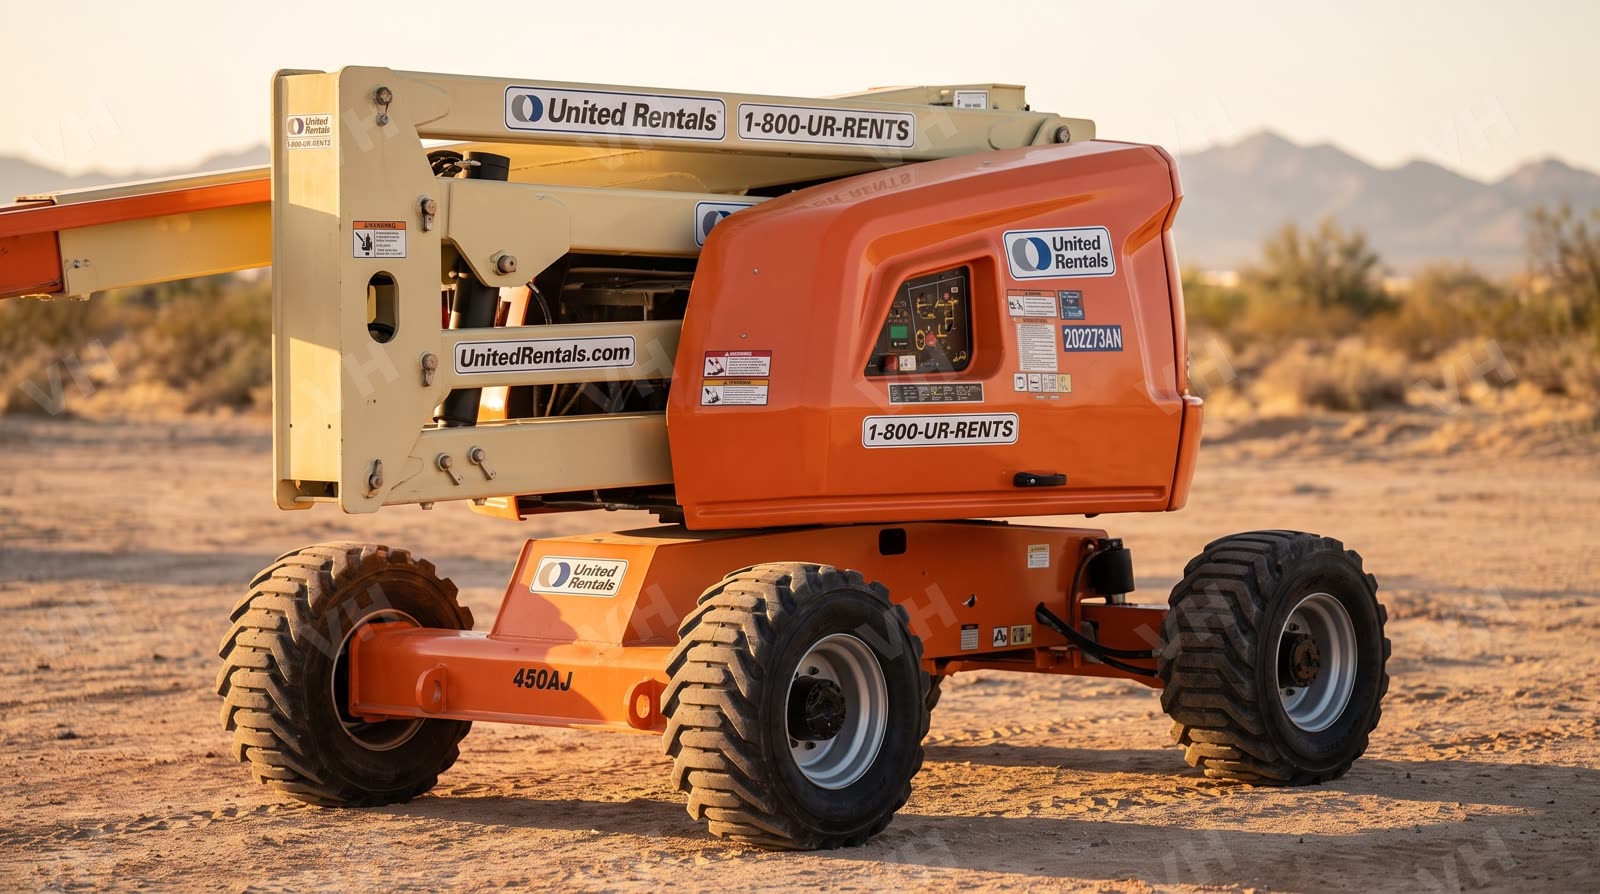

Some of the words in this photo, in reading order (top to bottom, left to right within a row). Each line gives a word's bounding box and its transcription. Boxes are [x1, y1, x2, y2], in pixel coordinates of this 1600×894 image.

[305, 117, 328, 126] United
[548, 98, 627, 126] United
[632, 103, 717, 131] Rentals
[305, 126, 331, 135] Rentals
[744, 112, 909, 141] 1-800-UR-RENTS
[1052, 235, 1100, 251] United
[1055, 252, 1109, 269] Rentals
[1064, 328, 1122, 349] 202273AN
[460, 345, 630, 367] UnitedRentals.com
[868, 420, 1014, 440] 1-800-UR-RENTS
[574, 563, 618, 577] United
[568, 577, 615, 591] Rentals
[513, 668, 573, 691] 450AJ
